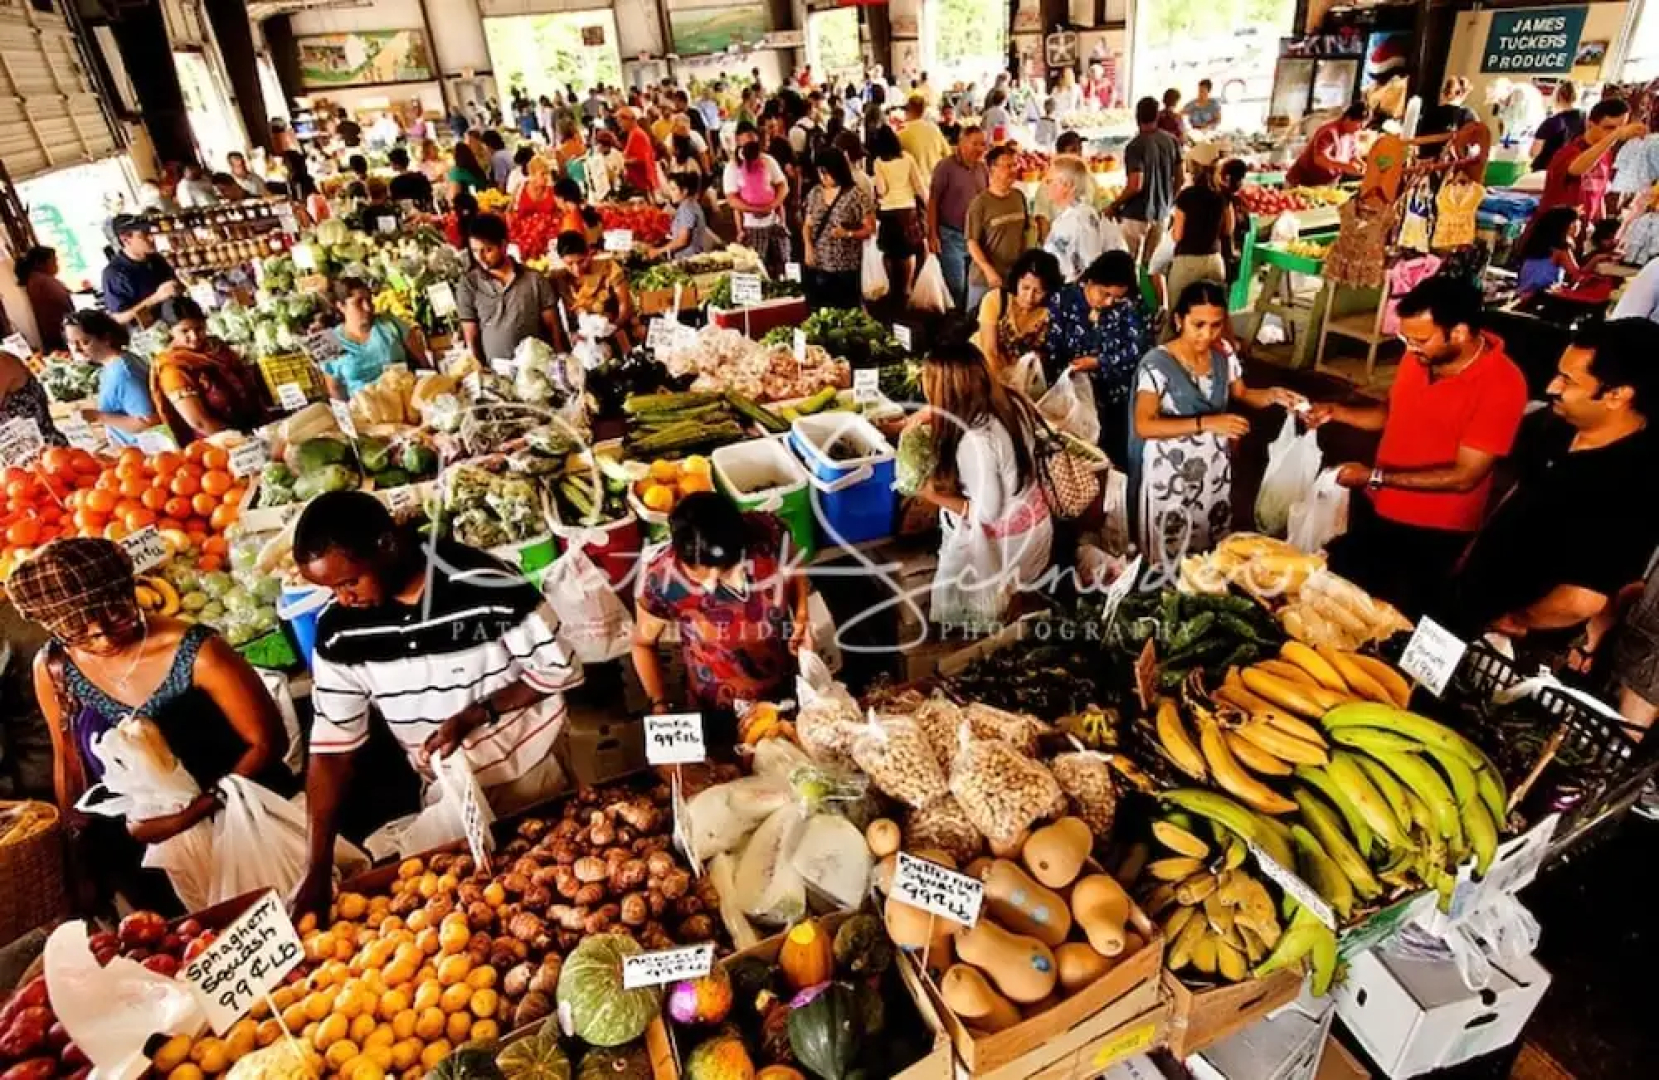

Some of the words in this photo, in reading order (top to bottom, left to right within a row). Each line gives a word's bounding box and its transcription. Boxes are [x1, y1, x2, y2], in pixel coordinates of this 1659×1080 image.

[1512, 16, 1566, 33] JAMES
[1500, 34, 1567, 50] TUCKERS
[1487, 52, 1568, 69] PRODUCE
